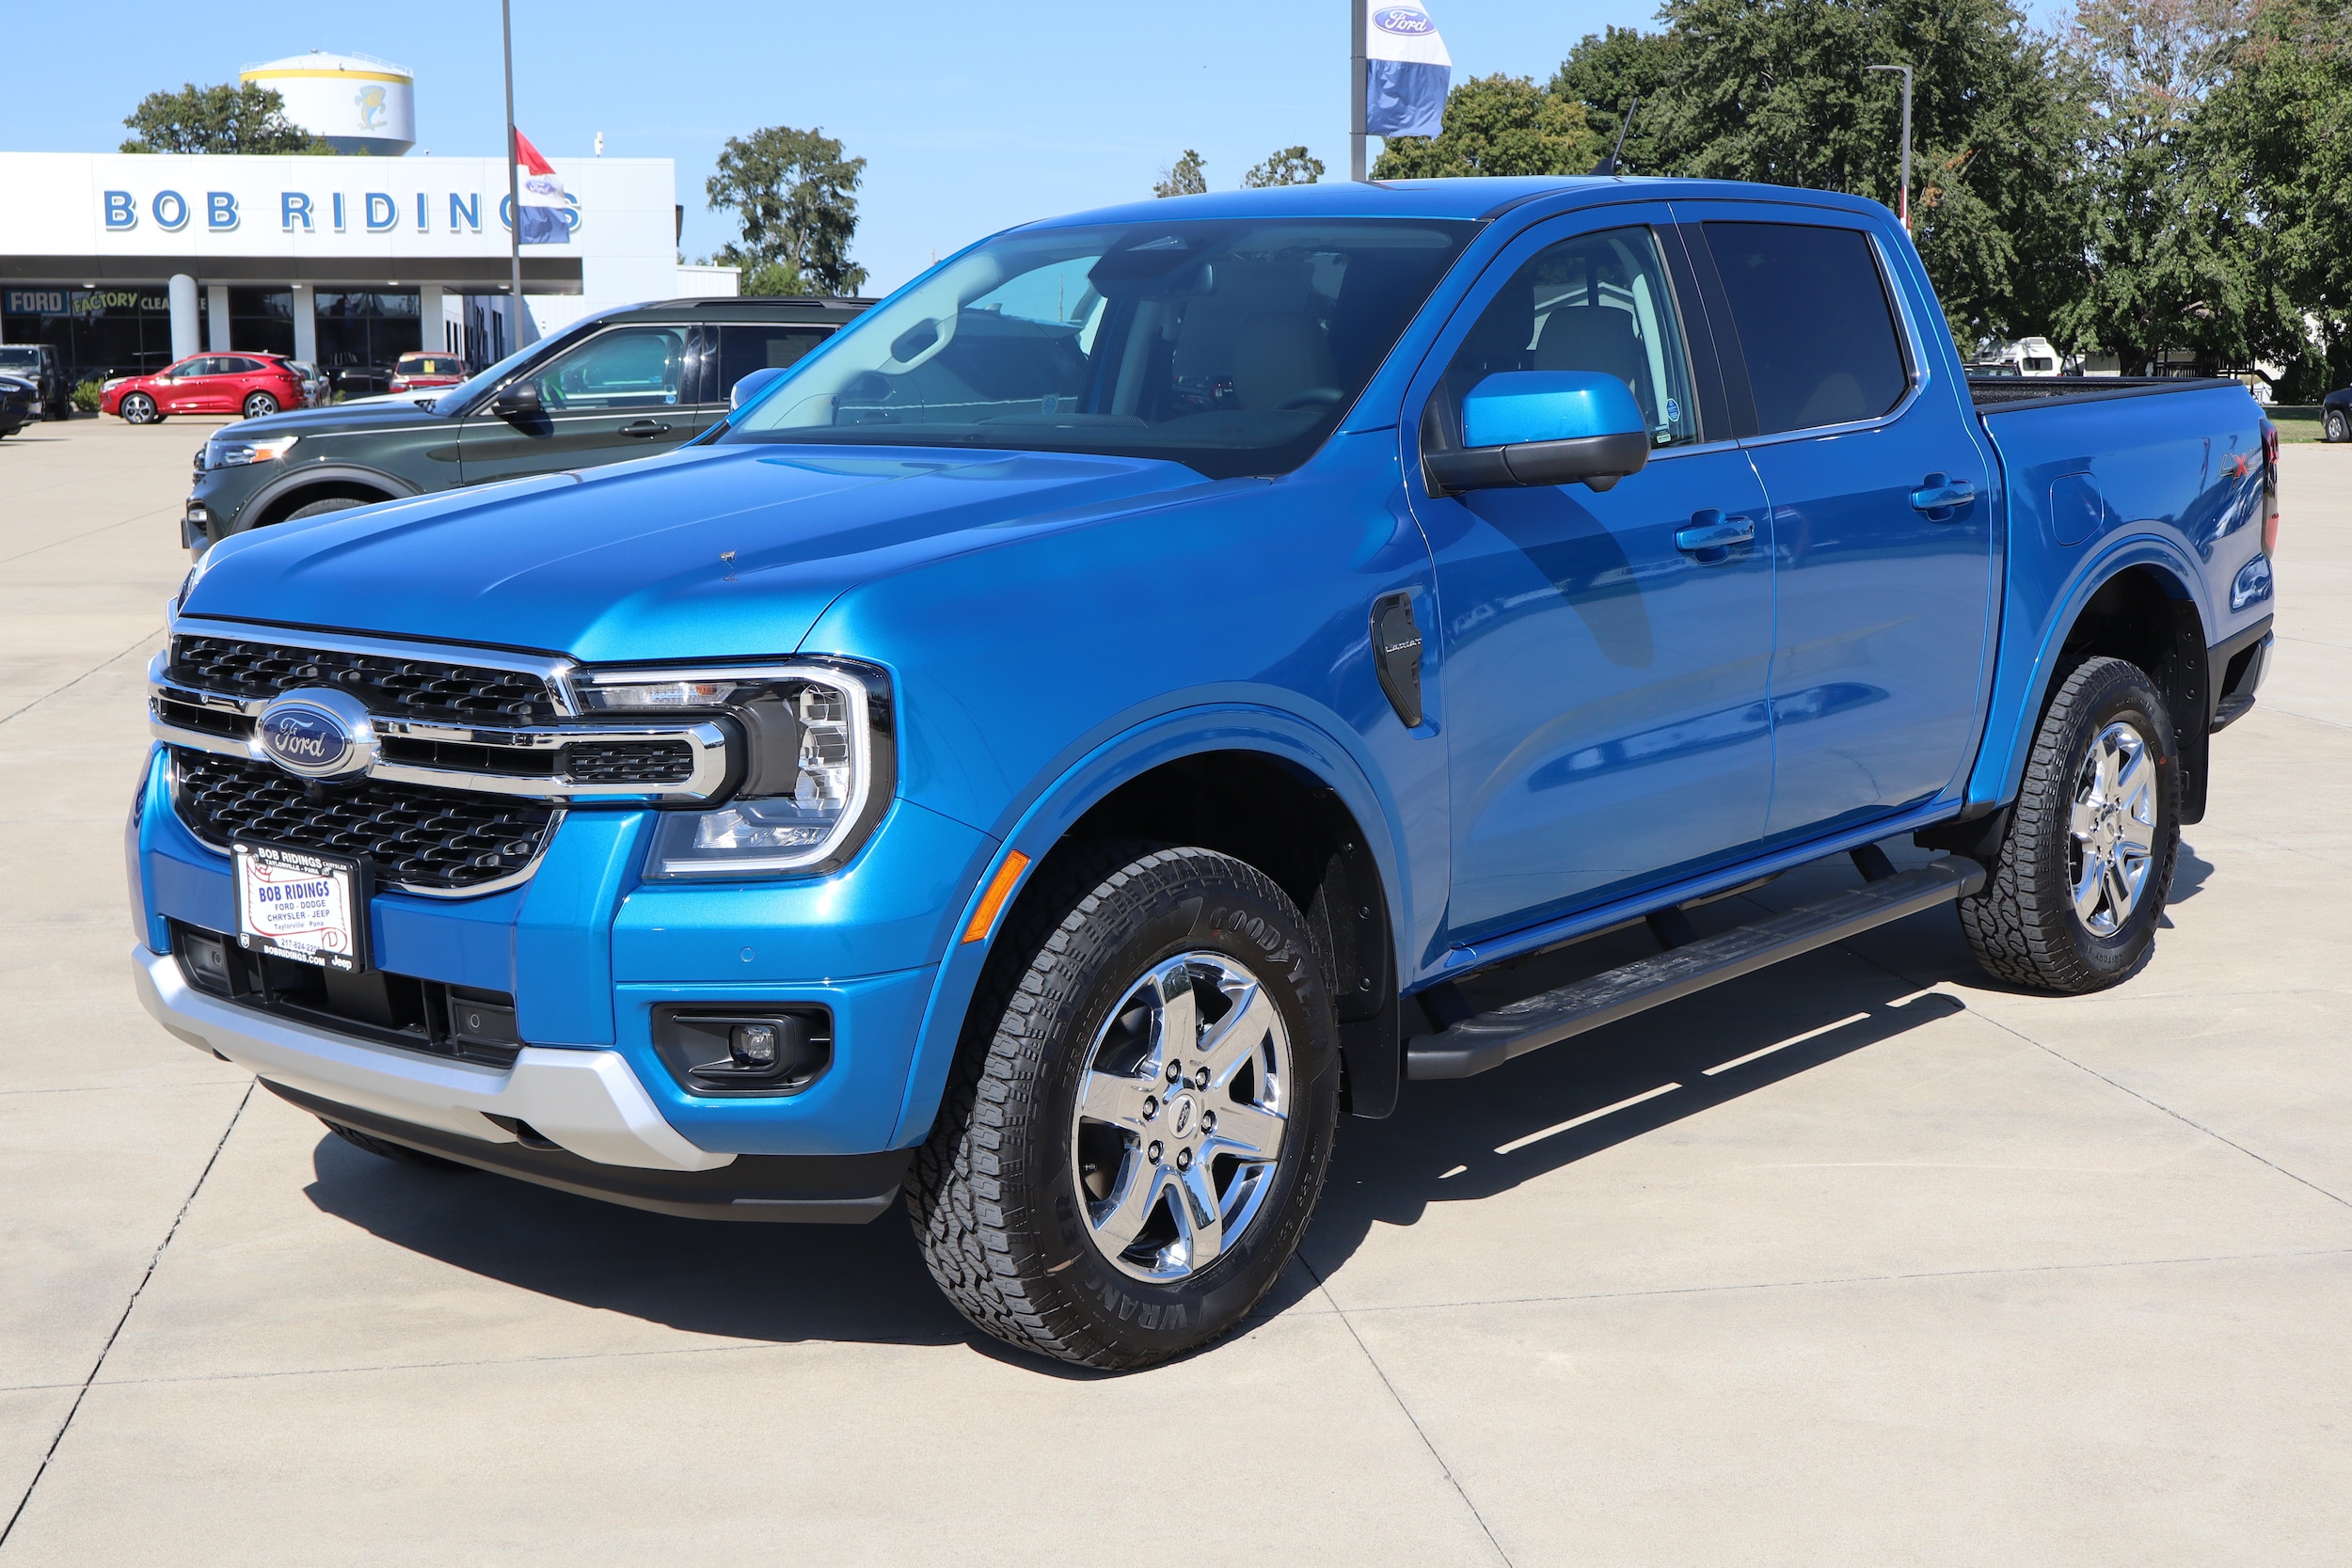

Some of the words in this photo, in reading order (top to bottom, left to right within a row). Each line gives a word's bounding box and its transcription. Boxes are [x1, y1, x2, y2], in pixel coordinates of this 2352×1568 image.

[1385, 10, 1427, 32] Ford
[529, 180, 552, 195] Ford
[103, 189, 240, 233] BOB
[10, 292, 63, 312] FORD
[72, 292, 138, 314] FACTORY
[140, 296, 207, 311] CLEAE
[275, 717, 326, 757] Ford
[258, 847, 279, 861] BOB
[280, 851, 322, 868] RIDINGS
[323, 862, 347, 871] CHYSLER
[265, 859, 300, 871] TAYLORVILLE
[304, 866, 320, 875] PANA
[259, 886, 282, 902] BOB
[284, 880, 330, 900] RIDINGS
[300, 900, 326, 909] DODGE
[267, 912, 306, 922] CHRYSLER
[311, 910, 330, 918] JEEP
[274, 922, 305, 930] Taylorville
[263, 945, 326, 967] BOBRIDINGS.COM
[331, 955, 353, 971] Jeep
